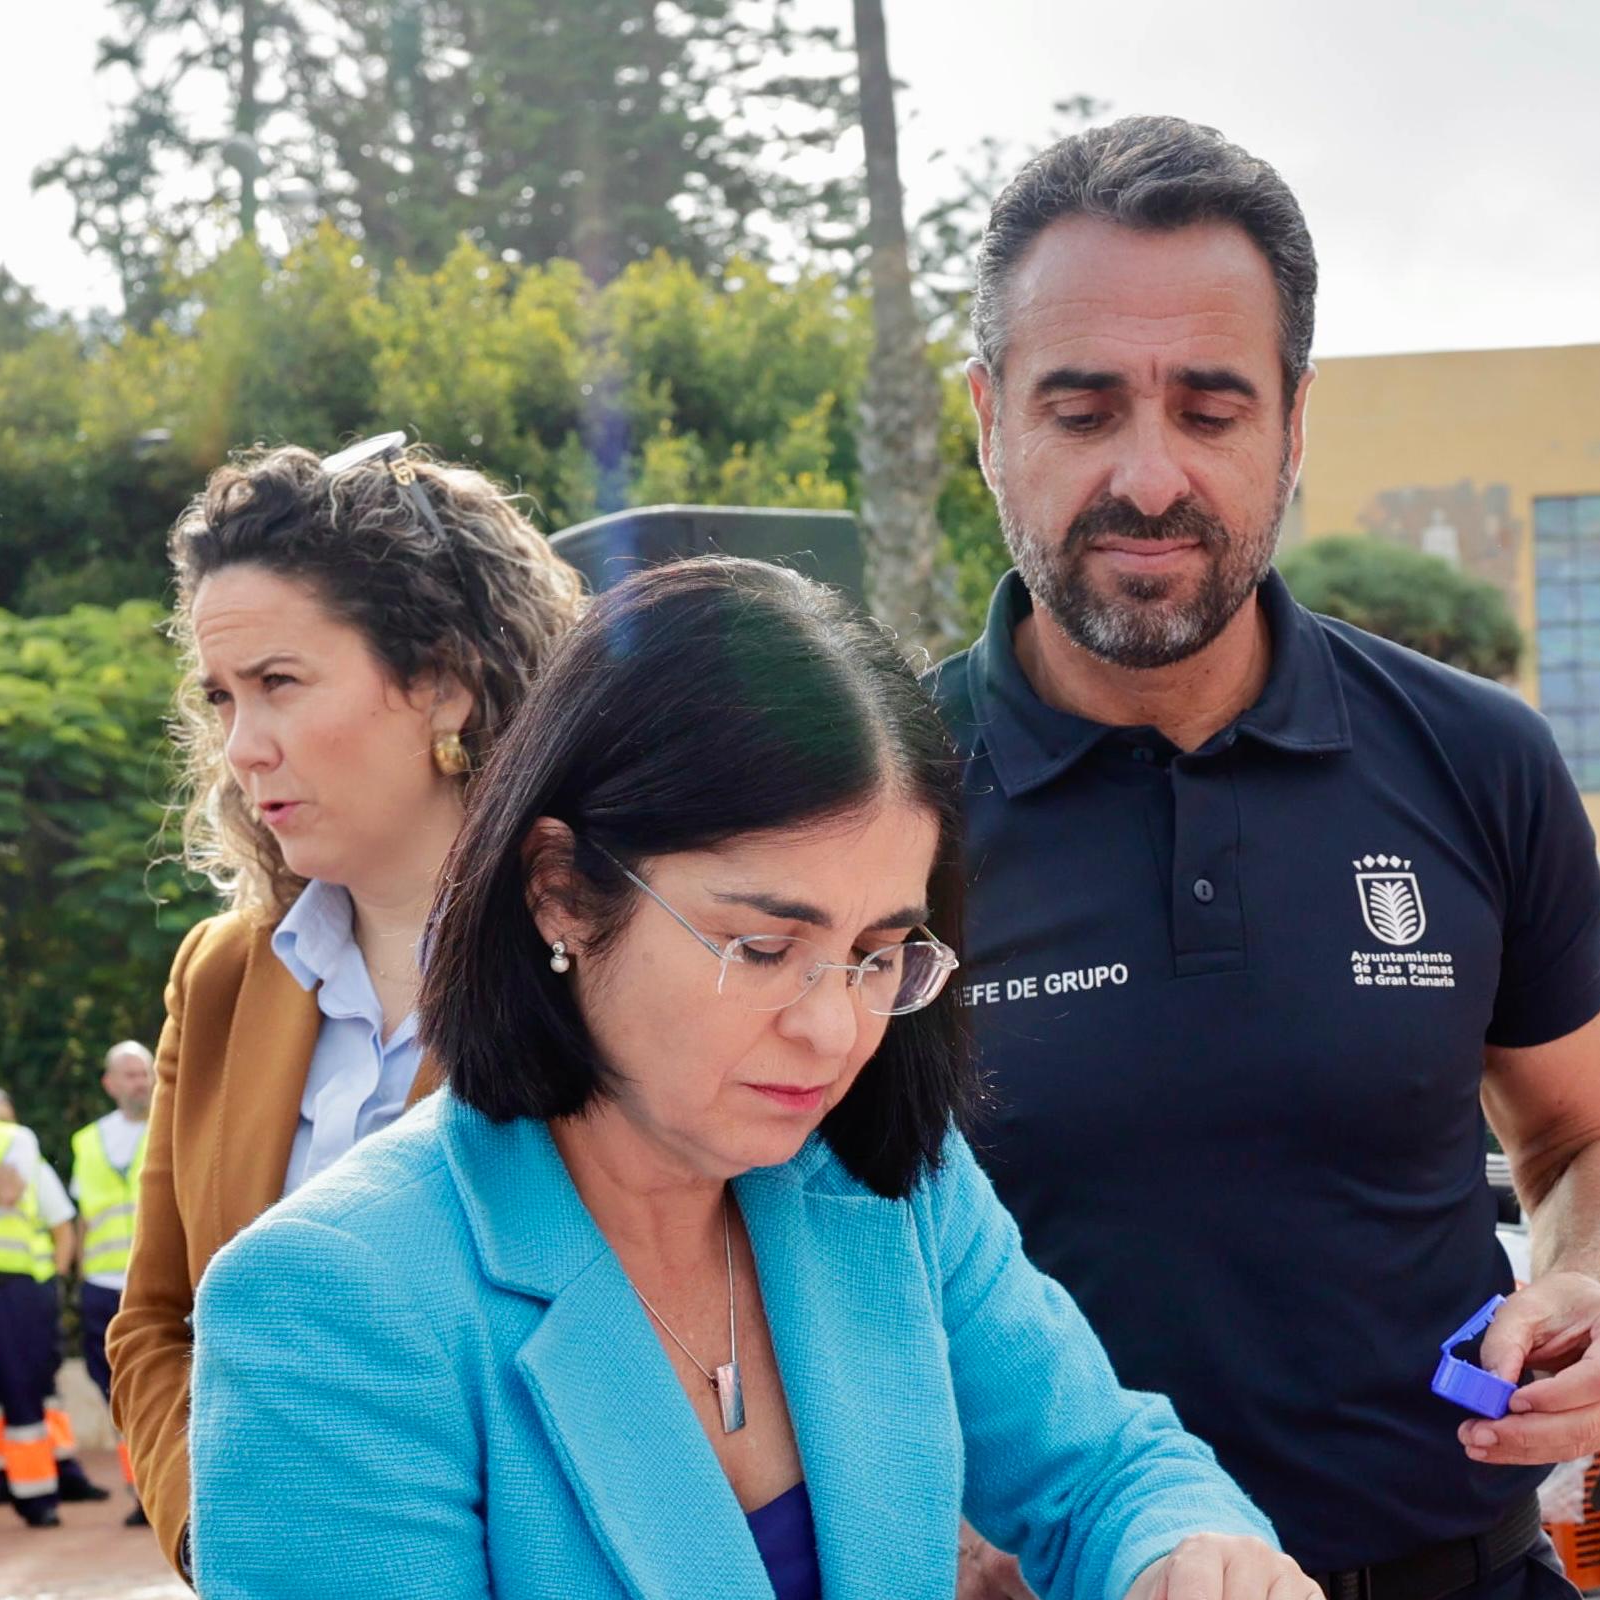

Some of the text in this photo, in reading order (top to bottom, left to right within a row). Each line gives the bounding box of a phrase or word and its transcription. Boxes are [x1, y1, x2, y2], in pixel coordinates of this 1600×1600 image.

[1351, 951, 1452, 964] Ayuntamiento
[1352, 963, 1454, 975] de Las Palmas
[960, 963, 1129, 1007] EFE DE GRUPO
[1354, 974, 1455, 987] de Gran Canaria
